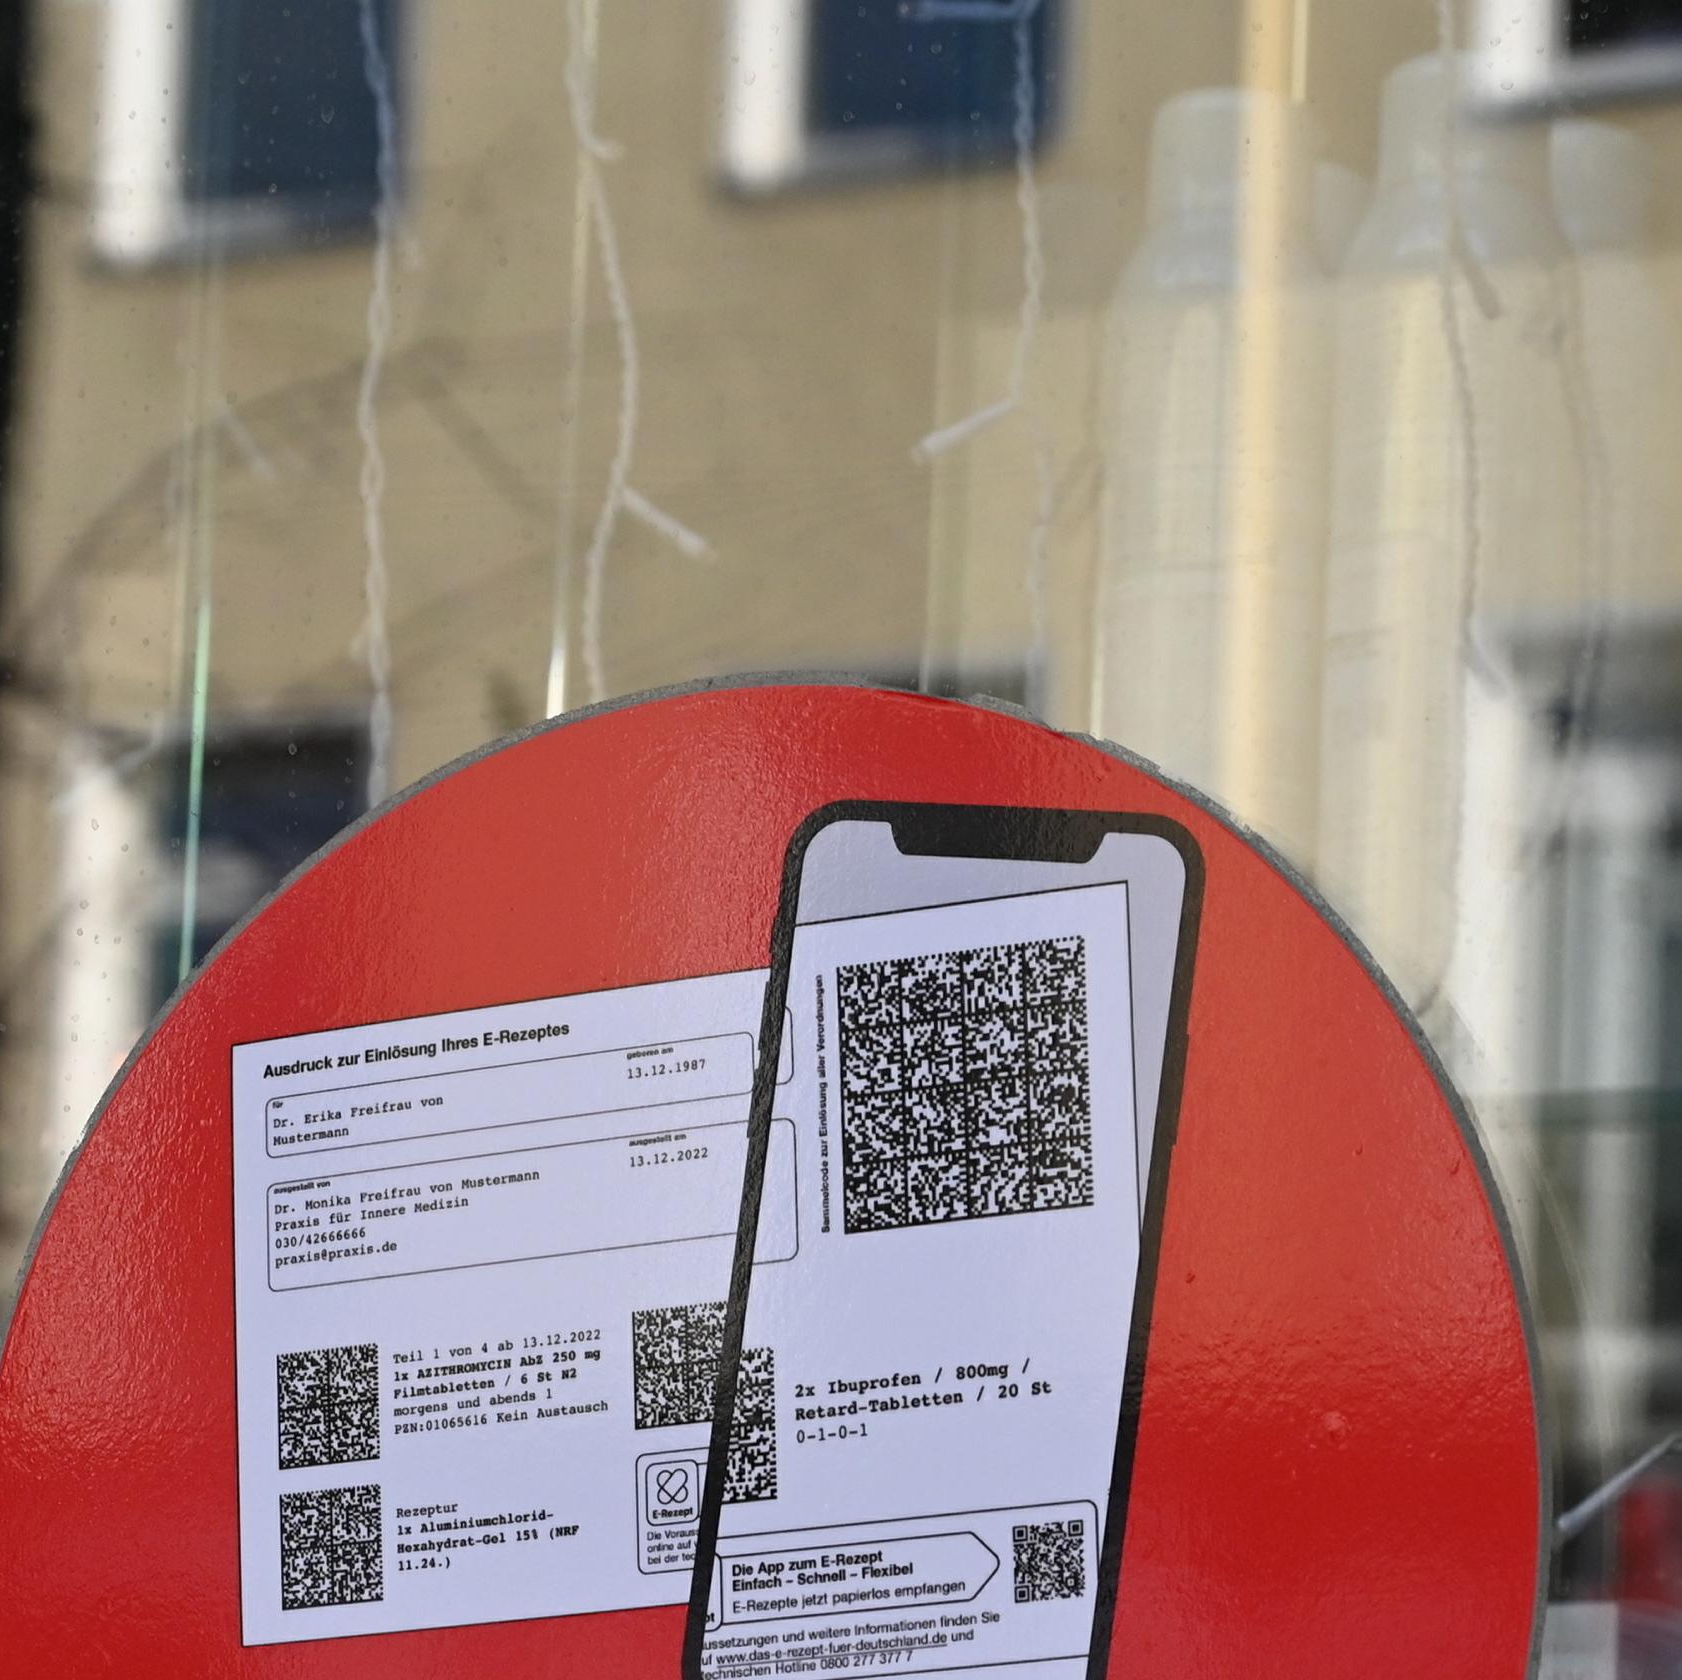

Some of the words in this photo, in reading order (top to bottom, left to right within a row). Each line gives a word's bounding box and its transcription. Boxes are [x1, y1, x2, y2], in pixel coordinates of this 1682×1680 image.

[815, 974, 826, 1054] Verordnungen
[263, 1055, 333, 1079] Ausdruck
[337, 1053, 361, 1068] zur
[364, 1041, 436, 1064] Einlösung
[441, 1036, 478, 1053] Ihres
[483, 1024, 570, 1046] E-Rezeptes
[626, 1048, 659, 1060] geboren
[661, 1047, 674, 1055] am
[627, 1058, 705, 1079] 13.12.1987
[817, 1055, 826, 1079] aller
[272, 1101, 283, 1109] für
[273, 1117, 295, 1128] Dr.
[304, 1109, 342, 1125] Erika
[350, 1101, 412, 1118] Freifrau
[420, 1096, 443, 1107] von
[817, 1081, 828, 1137] Einlösung
[273, 1126, 349, 1146] Mustermann
[629, 1134, 672, 1147] ausgestellt
[819, 1139, 829, 1158] zur
[630, 1147, 708, 1167] 13.12.2022
[273, 1182, 315, 1194] ausgestellt
[316, 1180, 331, 1188] von
[274, 1204, 296, 1215] Dr.
[305, 1195, 351, 1211] Monika
[360, 1186, 421, 1203] Freifrau
[429, 1182, 453, 1193] von
[461, 1171, 540, 1190] Mustermann
[820, 1159, 831, 1234] Sammelcode
[275, 1216, 320, 1232] Praxis
[329, 1212, 351, 1224] für
[360, 1206, 406, 1220] Innere
[413, 1196, 469, 1213] Medizin
[275, 1226, 366, 1249] 030/42666666
[275, 1240, 397, 1268] praxis@praxis.de
[393, 1350, 423, 1364] Teil
[434, 1348, 440, 1359] 1
[449, 1346, 472, 1357] von
[481, 1342, 488, 1353] 4
[497, 1340, 514, 1351] ab
[523, 1329, 601, 1348] 13.12.2022
[394, 1372, 409, 1382] 1x
[417, 1358, 512, 1379] AZITHROMYCIN
[519, 1354, 543, 1367] AbZ
[552, 1350, 577, 1363] 250
[584, 1349, 601, 1361] mg
[794, 1384, 815, 1398] 2x
[828, 1372, 921, 1395] Ibuprofen
[934, 1367, 943, 1384] /
[955, 1363, 1009, 1380] 800mg
[1021, 1357, 1030, 1374] /
[393, 1380, 495, 1399] Filmtabletten
[505, 1374, 511, 1387] /
[520, 1373, 528, 1384] 6
[537, 1371, 552, 1382] St
[561, 1368, 577, 1379] N2
[393, 1402, 448, 1417] morgens
[457, 1396, 480, 1409] und
[489, 1390, 536, 1406] abends
[546, 1387, 552, 1399] 1
[794, 1391, 964, 1421] Retard-Tabletten
[976, 1386, 985, 1402] /
[997, 1383, 1019, 1399] 20
[1031, 1380, 1052, 1396] St
[394, 1413, 487, 1435] PZN:01065616
[496, 1409, 528, 1423] Kein
[536, 1400, 609, 1418] Austausch
[796, 1423, 868, 1443] 0-1-0-1
[396, 1502, 458, 1518] Rezeptur
[397, 1525, 412, 1535] 1x
[420, 1509, 554, 1533] Aluminiumchlorid-
[652, 1507, 693, 1519] E-Rezept
[396, 1532, 506, 1554] Hexahydrat-Gel
[516, 1529, 539, 1541] 15%
[549, 1525, 580, 1540] (NRF
[646, 1531, 662, 1541] Die
[646, 1543, 674, 1553] online
[677, 1540, 691, 1549] auf
[398, 1557, 451, 1571] 11.24.)
[647, 1556, 661, 1565] bei
[664, 1554, 679, 1563] der
[731, 1563, 753, 1577] Die
[757, 1561, 785, 1575] App
[788, 1558, 817, 1572] zum
[820, 1550, 883, 1568] E-Rezept
[731, 1576, 782, 1592] Einfach
[797, 1569, 846, 1585] Schnell
[861, 1562, 913, 1579] Flexibel
[732, 1597, 798, 1614] E-Rezepte
[802, 1593, 828, 1609] jetzt
[832, 1588, 890, 1607] papierlos
[894, 1581, 966, 1597] empfangen
[703, 1634, 779, 1651] ussetzungen
[782, 1630, 805, 1643] und
[808, 1627, 851, 1641] weitere
[854, 1618, 936, 1636] Informationen
[940, 1614, 977, 1627] finden
[981, 1611, 1000, 1624] Sie
[702, 1654, 712, 1666] uf
[717, 1632, 948, 1666] www.das-e-rezept-fuer-deutschland.de
[951, 1629, 974, 1642] und
[775, 1658, 816, 1674] Hotline
[820, 1655, 849, 1670] 0800
[853, 1652, 875, 1666] 277
[879, 1650, 901, 1665] 377
[905, 1649, 913, 1662] 7
